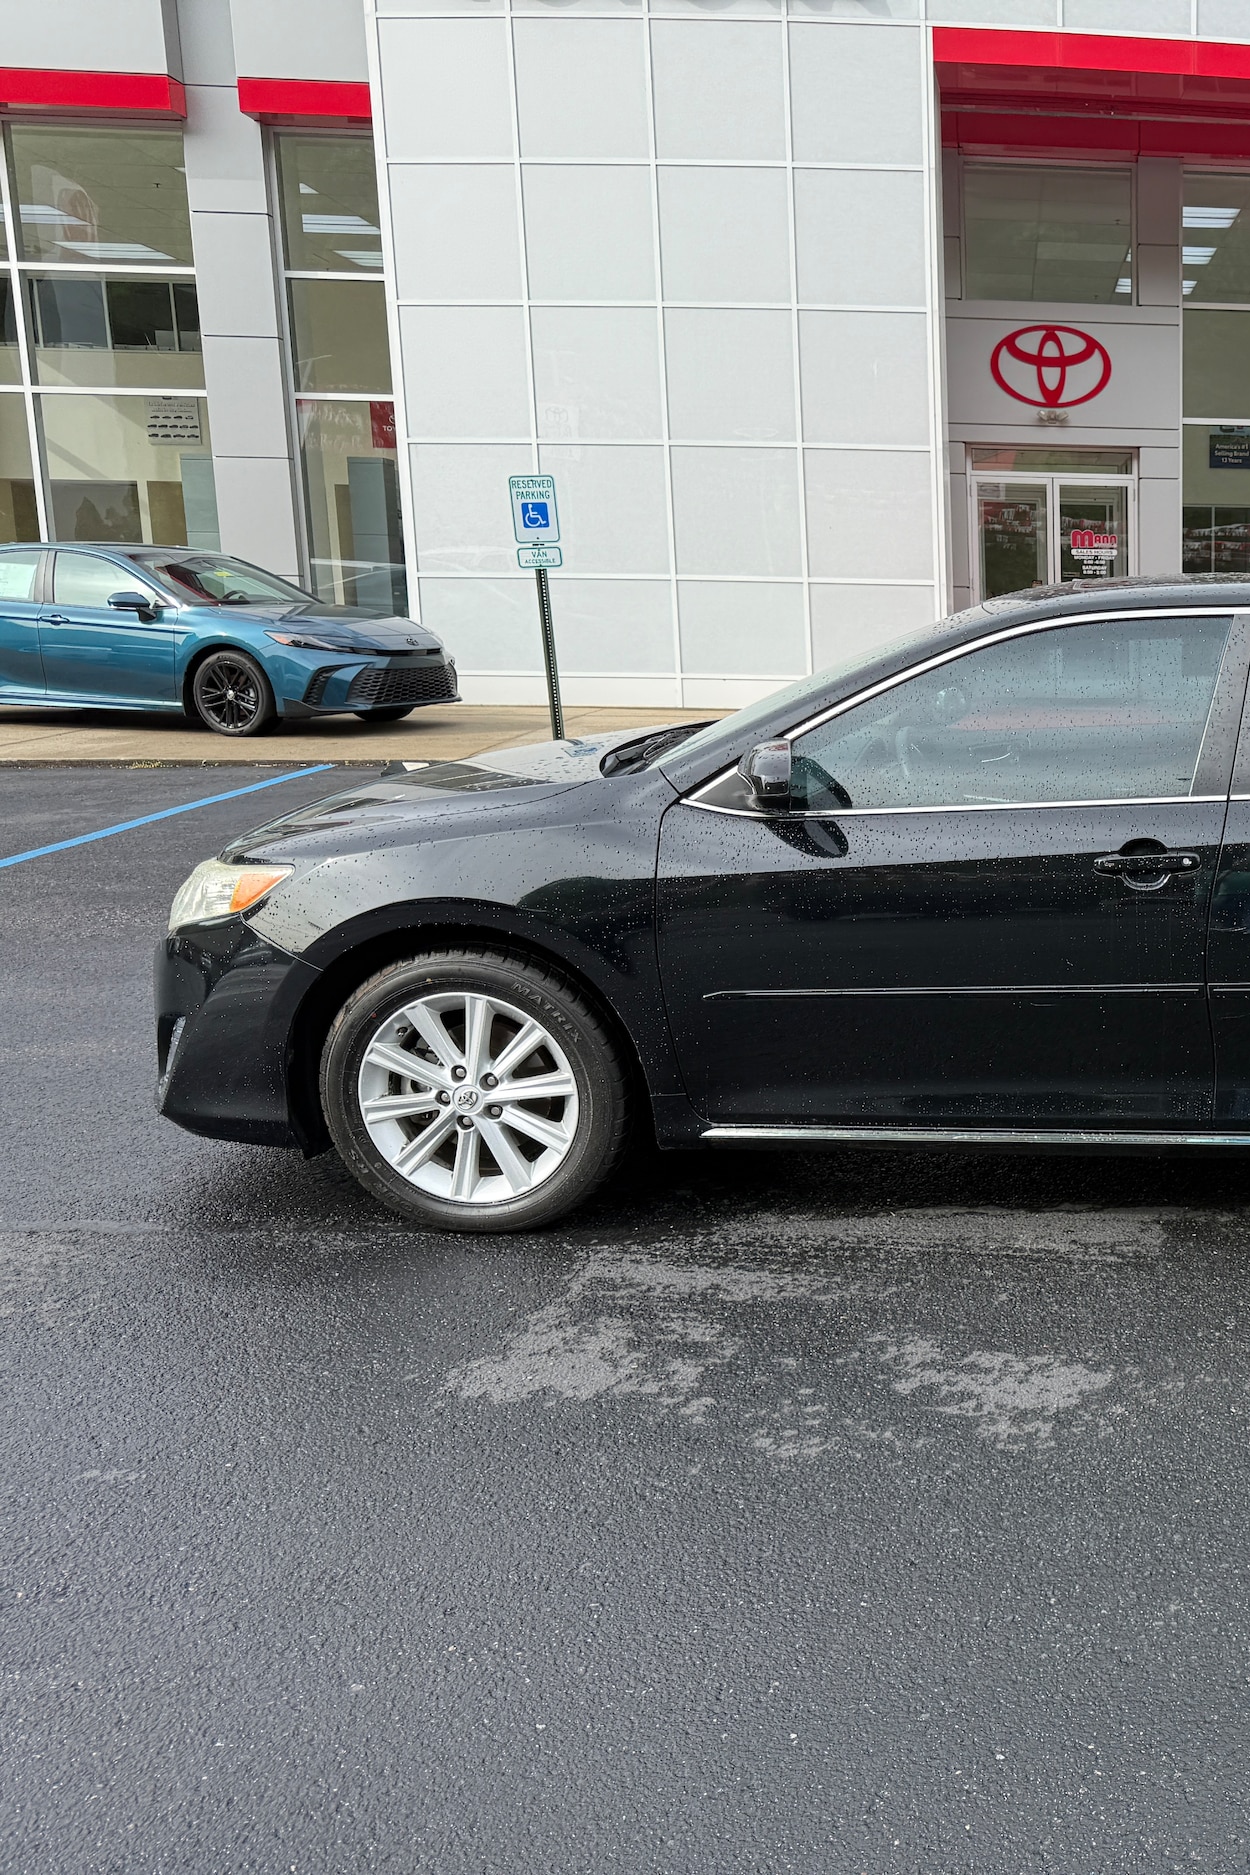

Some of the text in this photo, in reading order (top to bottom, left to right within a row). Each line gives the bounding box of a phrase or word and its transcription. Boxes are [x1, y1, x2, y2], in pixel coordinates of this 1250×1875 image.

[511, 479, 552, 489] RESERVED
[515, 490, 551, 500] PARKING
[531, 550, 548, 559] VAN
[510, 981, 584, 1044] MATRIX
